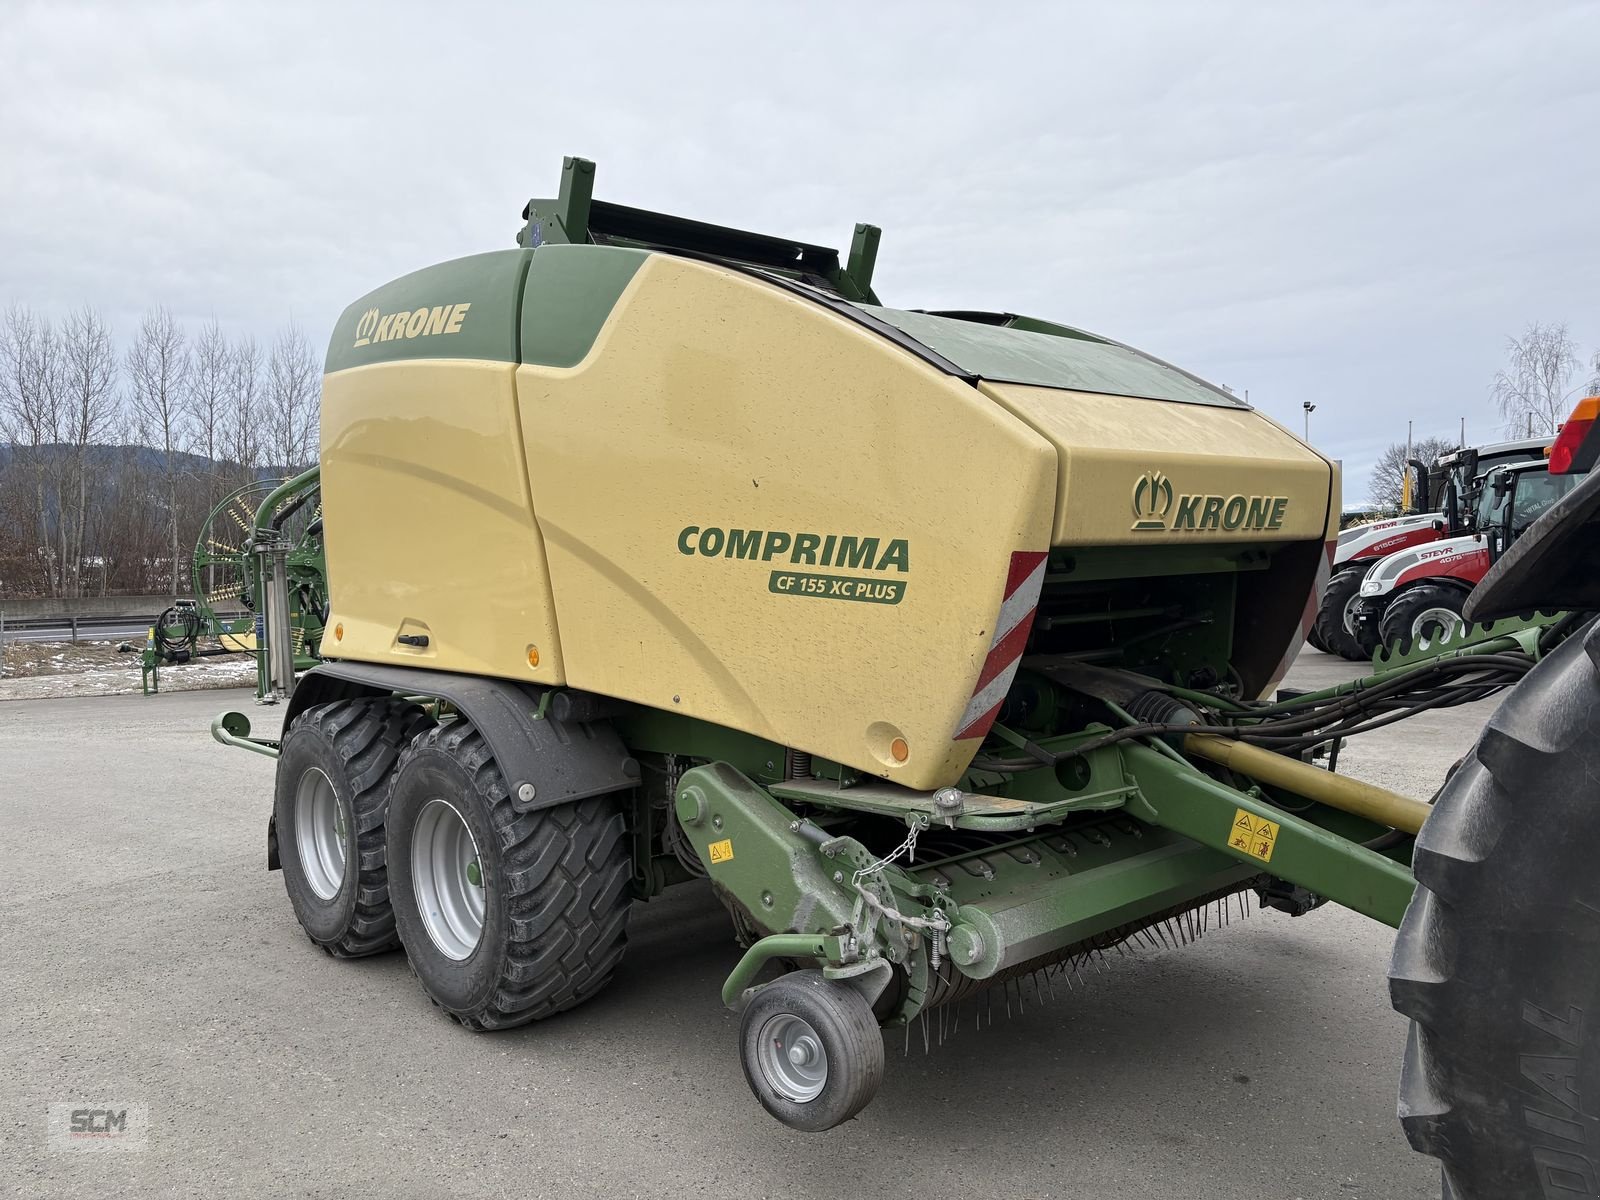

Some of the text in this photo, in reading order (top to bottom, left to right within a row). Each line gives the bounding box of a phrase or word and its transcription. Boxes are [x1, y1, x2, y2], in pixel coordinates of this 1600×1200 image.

[372, 302, 472, 344] KRONE
[1170, 494, 1289, 531] KRONE
[677, 525, 910, 573] COMPRIMA
[1420, 547, 1454, 560] STEYR
[1439, 554, 1463, 564] 4075
[776, 575, 897, 600] CF 155 XC PLUS
